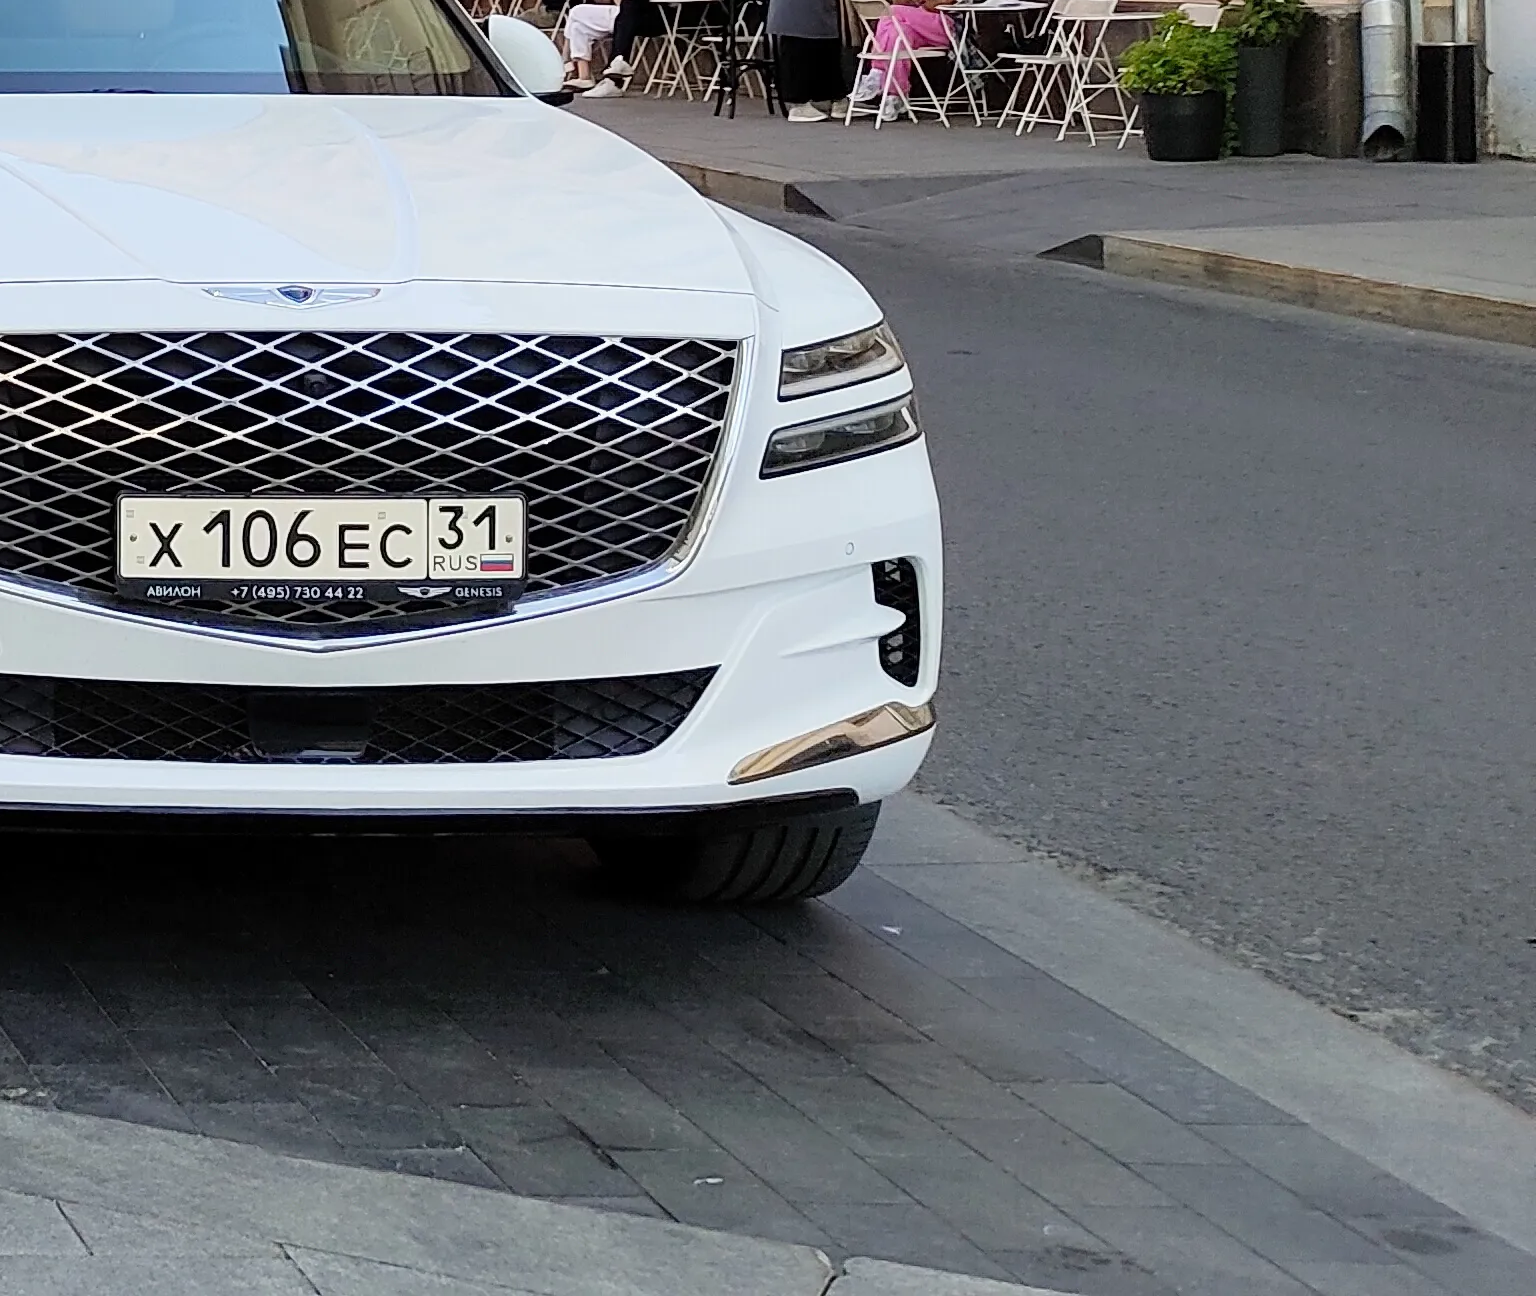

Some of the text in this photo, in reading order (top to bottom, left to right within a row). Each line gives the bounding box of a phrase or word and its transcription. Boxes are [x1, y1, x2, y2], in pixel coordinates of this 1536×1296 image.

[437, 504, 498, 551] 31
[432, 554, 478, 572] RUS
[146, 585, 503, 601] АВИЛОН +7 (495) 730 44 22 GENESIS
